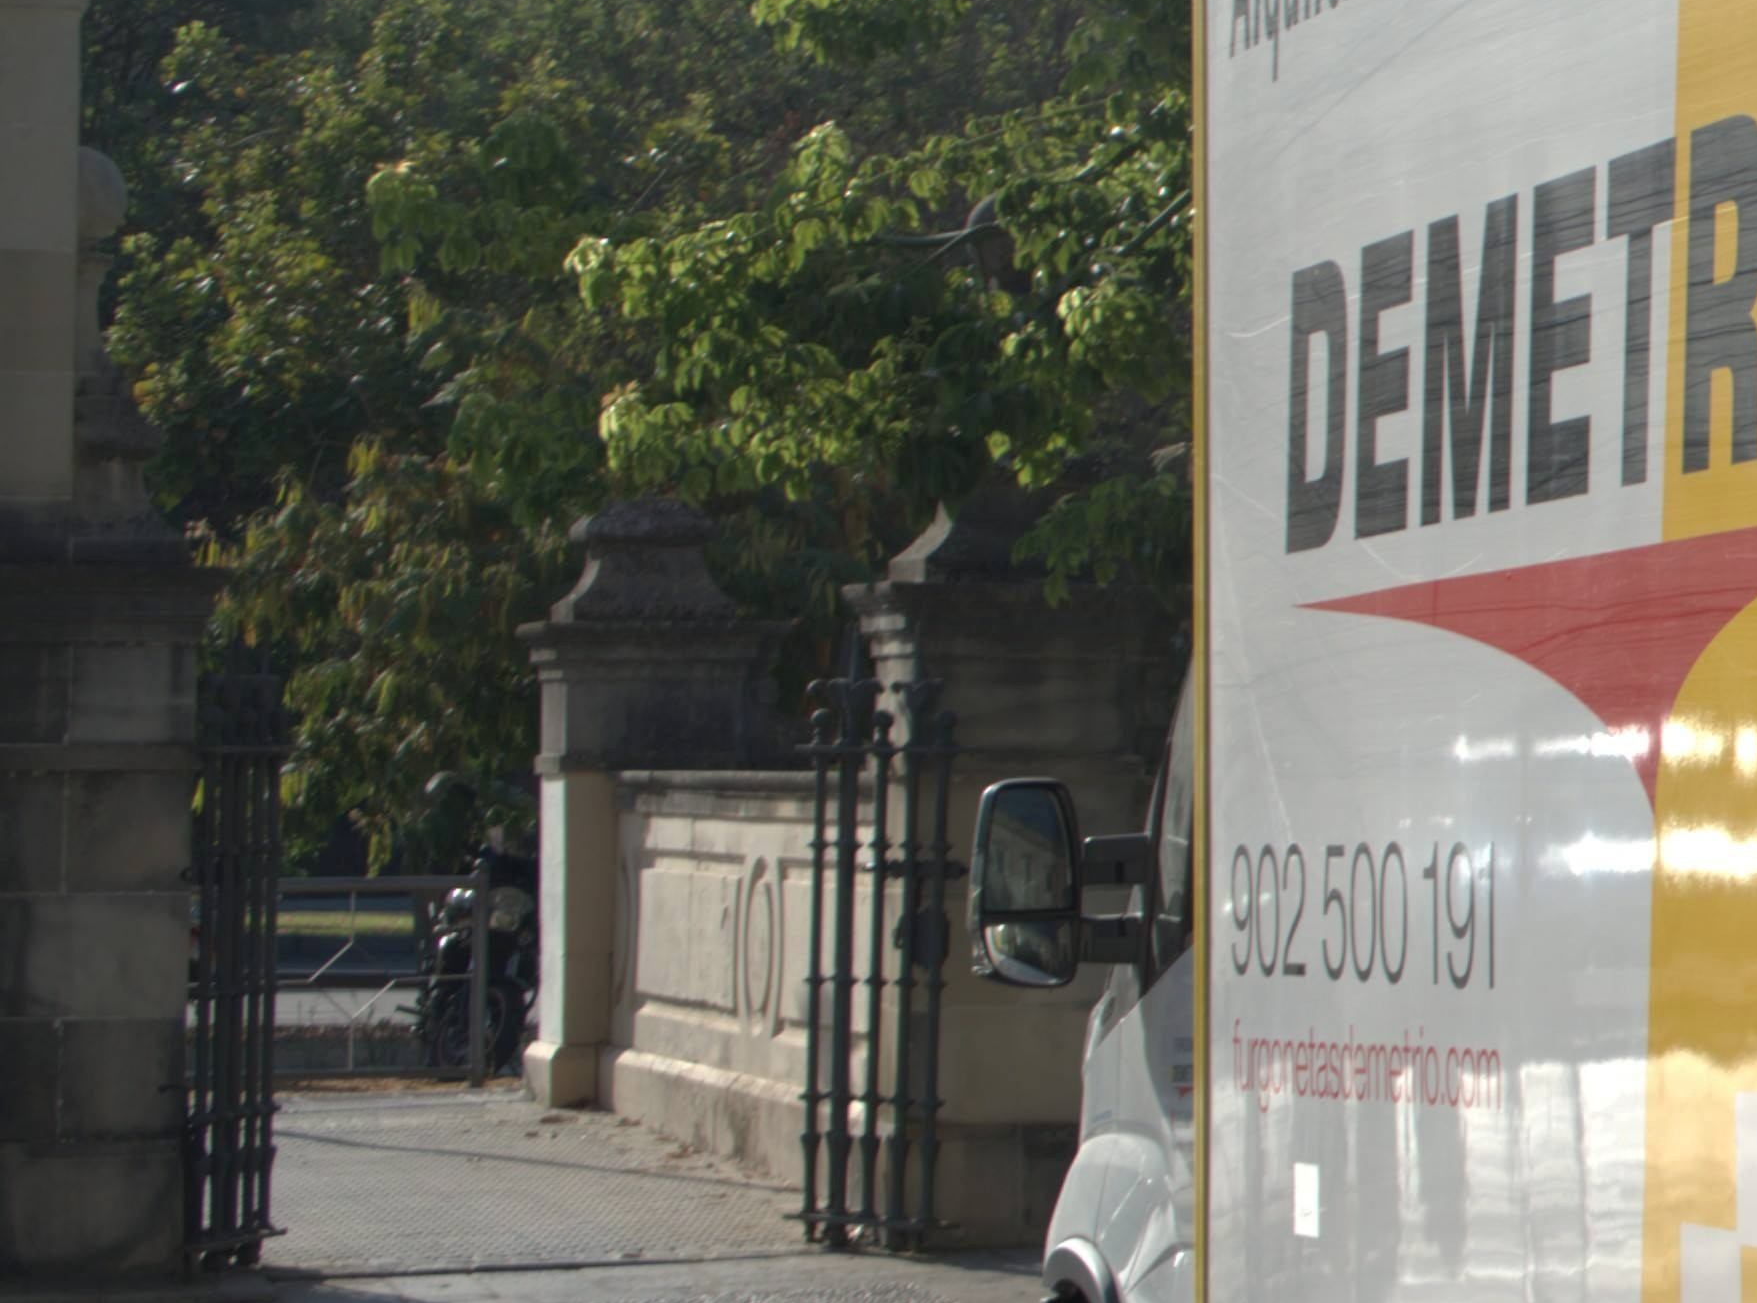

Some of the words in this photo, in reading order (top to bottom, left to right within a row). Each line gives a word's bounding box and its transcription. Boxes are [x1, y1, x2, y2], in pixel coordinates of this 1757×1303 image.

[1231, 843, 1306, 978] 902
[1322, 841, 1407, 985] 500
[1422, 841, 1495, 990] 191
[1232, 1018, 1502, 1114] furgonetasdemetrio.com
